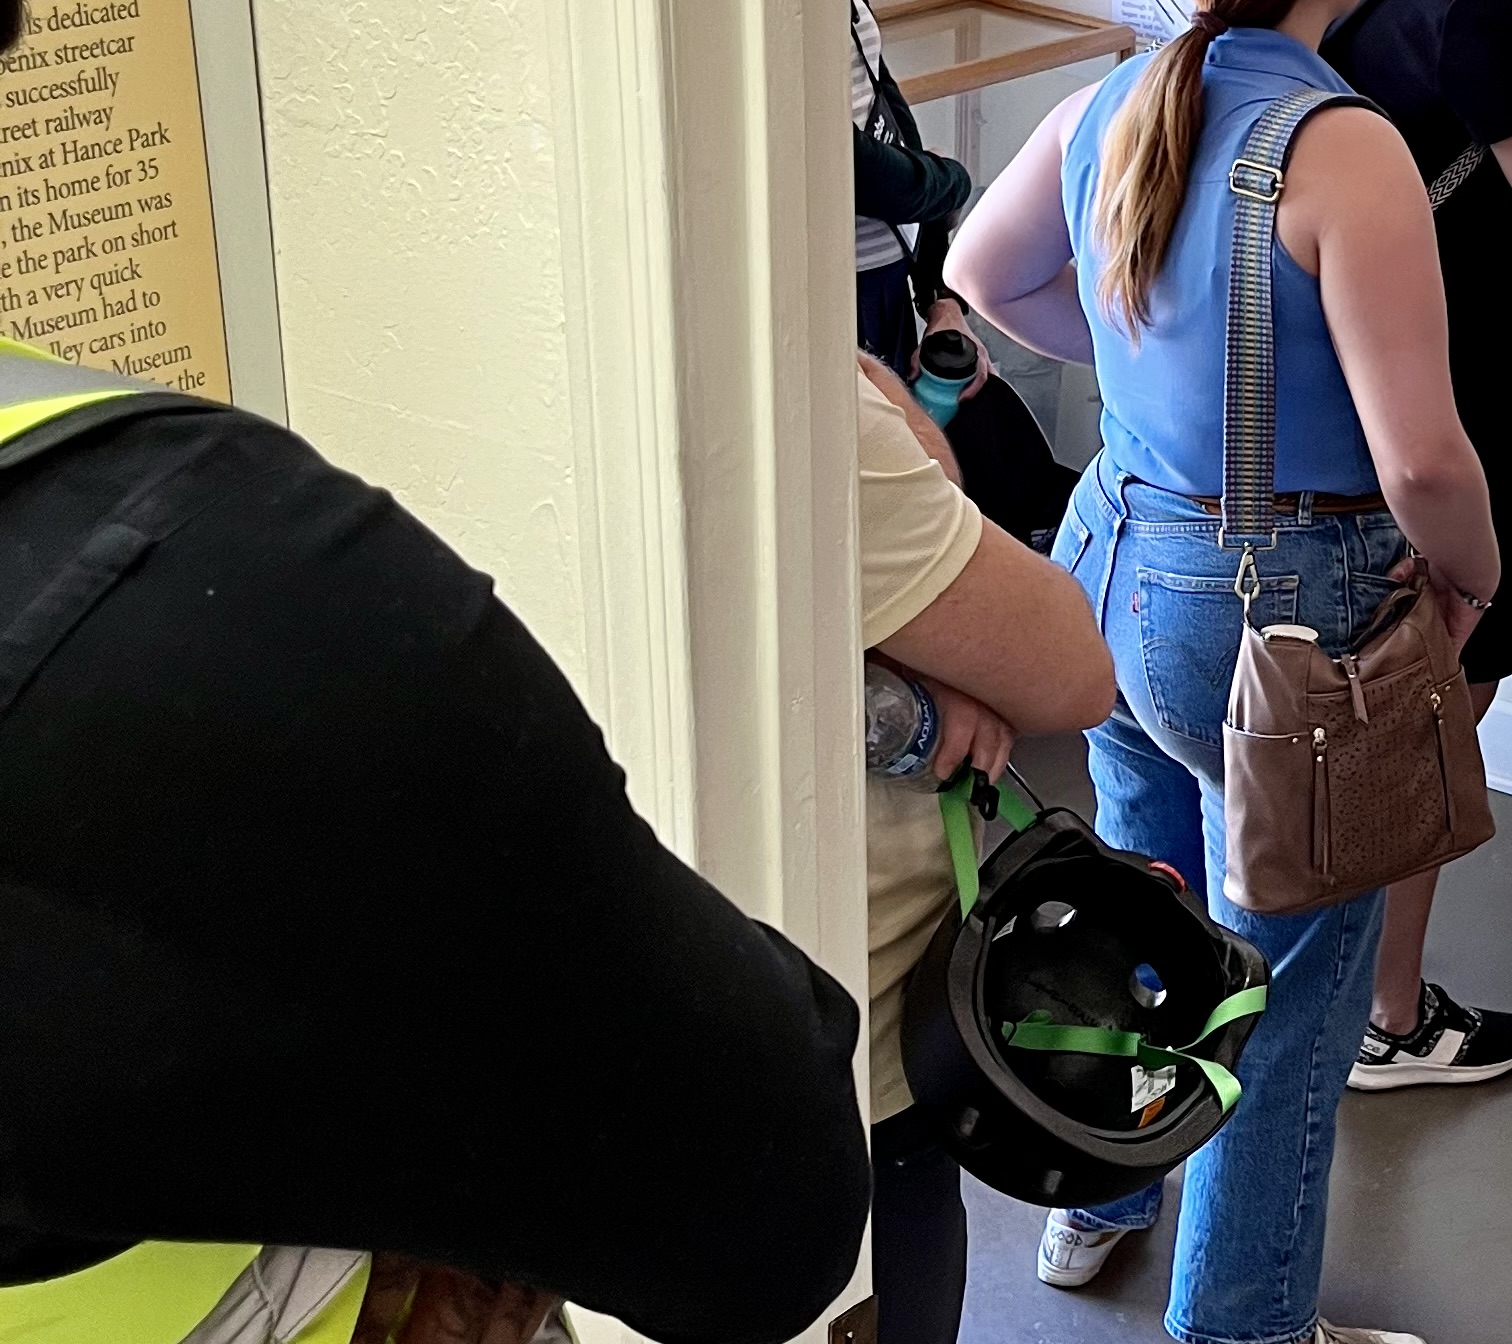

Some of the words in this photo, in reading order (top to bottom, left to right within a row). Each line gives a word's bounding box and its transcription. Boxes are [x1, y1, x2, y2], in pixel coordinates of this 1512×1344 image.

[54, 36, 135, 66] streetcar
[6, 66, 119, 108] successfully
[0, 118, 40, 143] reet
[45, 106, 114, 136] railway
[38, 148, 56, 170] at
[61, 137, 123, 165] Hance
[127, 122, 172, 151] Park
[17, 186, 40, 208] its
[43, 176, 101, 202] home
[105, 164, 132, 189] for
[137, 157, 159, 182] 35
[11, 217, 43, 243] the
[48, 198, 133, 235] Museum
[137, 192, 172, 214] was
[17, 250, 48, 276] the
[53, 236, 98, 274] park
[102, 235, 126, 254] on
[131, 220, 178, 248] short
[27, 289, 38, 306] a
[42, 277, 84, 302] very
[90, 258, 143, 296] quick
[10, 307, 98, 341] Museum
[101, 289, 138, 320] had
[142, 290, 160, 308] to
[89, 331, 126, 354] cars
[130, 320, 167, 344] into
[111, 344, 193, 377] Museum
[178, 368, 206, 392] the
